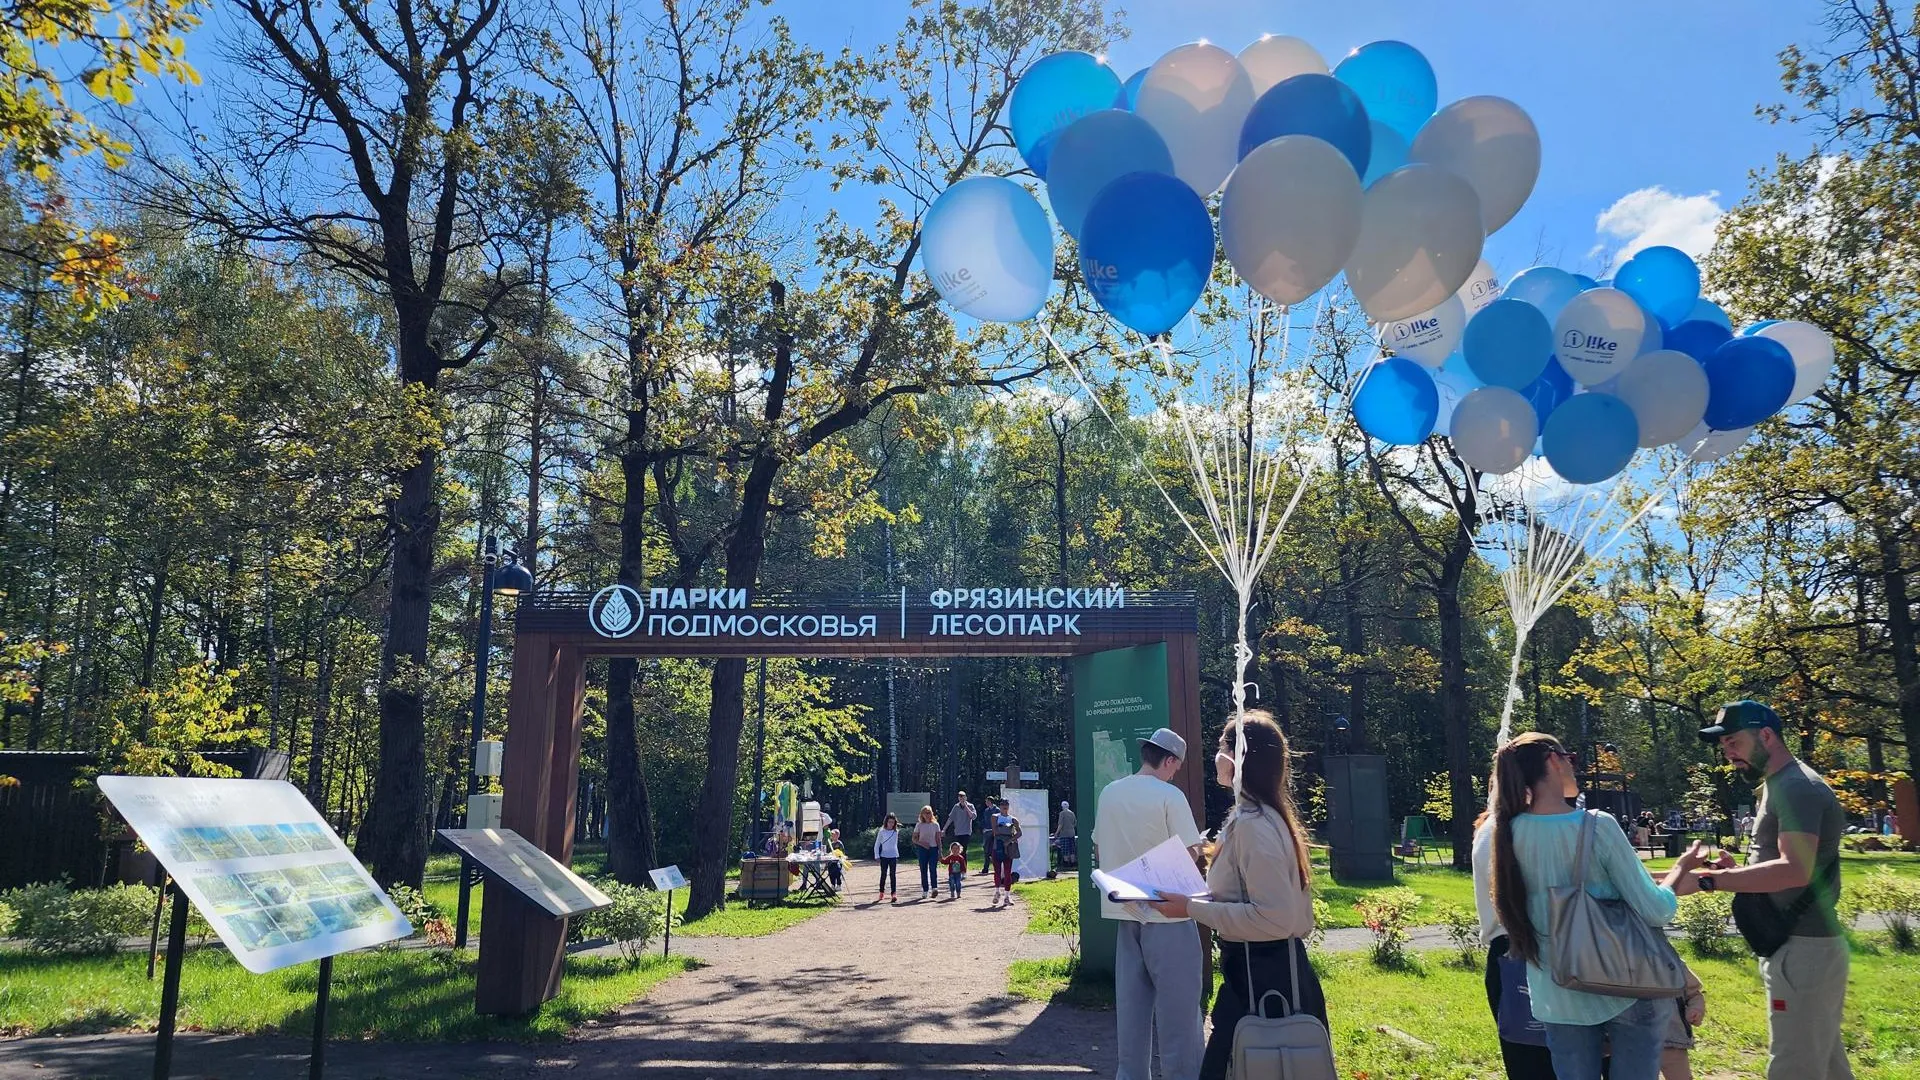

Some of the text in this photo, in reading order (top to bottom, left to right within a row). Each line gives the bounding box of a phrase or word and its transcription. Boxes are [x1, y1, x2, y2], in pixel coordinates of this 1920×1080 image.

[648, 587, 746, 610] ПАРКИ
[930, 581, 1125, 609] ФРЯЗИНСКИЙ
[647, 614, 877, 638] ПОДМОСКОВЬЯ
[930, 612, 1081, 636] ЛЕСОПАРК
[1086, 709, 1093, 717] ВО
[1093, 705, 1125, 715] ФРЯЗИНСКИЙ
[1094, 696, 1143, 708] ДОБРО ПОЖАЛОВАТЬ
